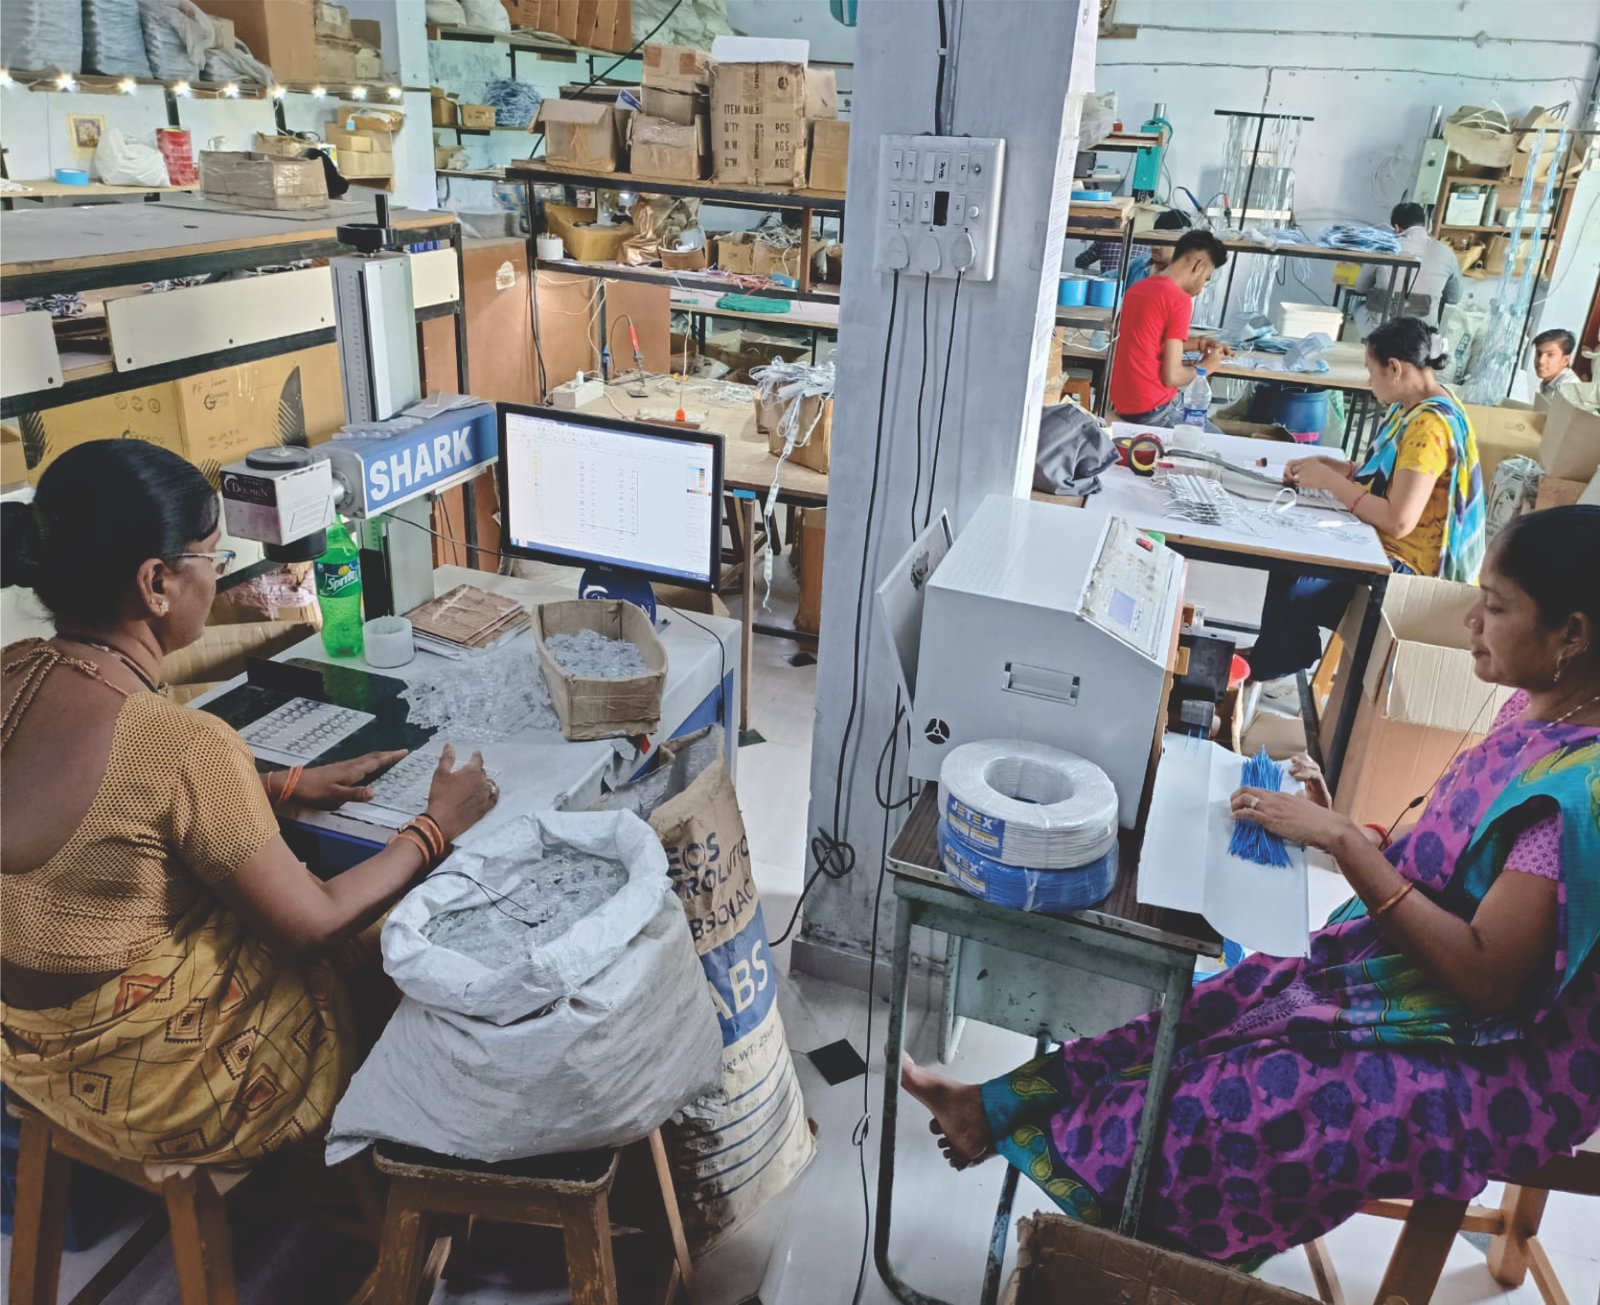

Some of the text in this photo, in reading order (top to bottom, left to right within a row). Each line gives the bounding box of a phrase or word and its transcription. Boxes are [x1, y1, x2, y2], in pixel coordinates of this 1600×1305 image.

[724, 103, 741, 115] ITEM
[775, 122, 790, 134] PCS
[775, 140, 790, 152] KGS
[775, 158, 790, 169] KGS
[368, 426, 473, 501] SHARK
[952, 801, 992, 830] JETEX
[707, 940, 768, 1020] ABS
